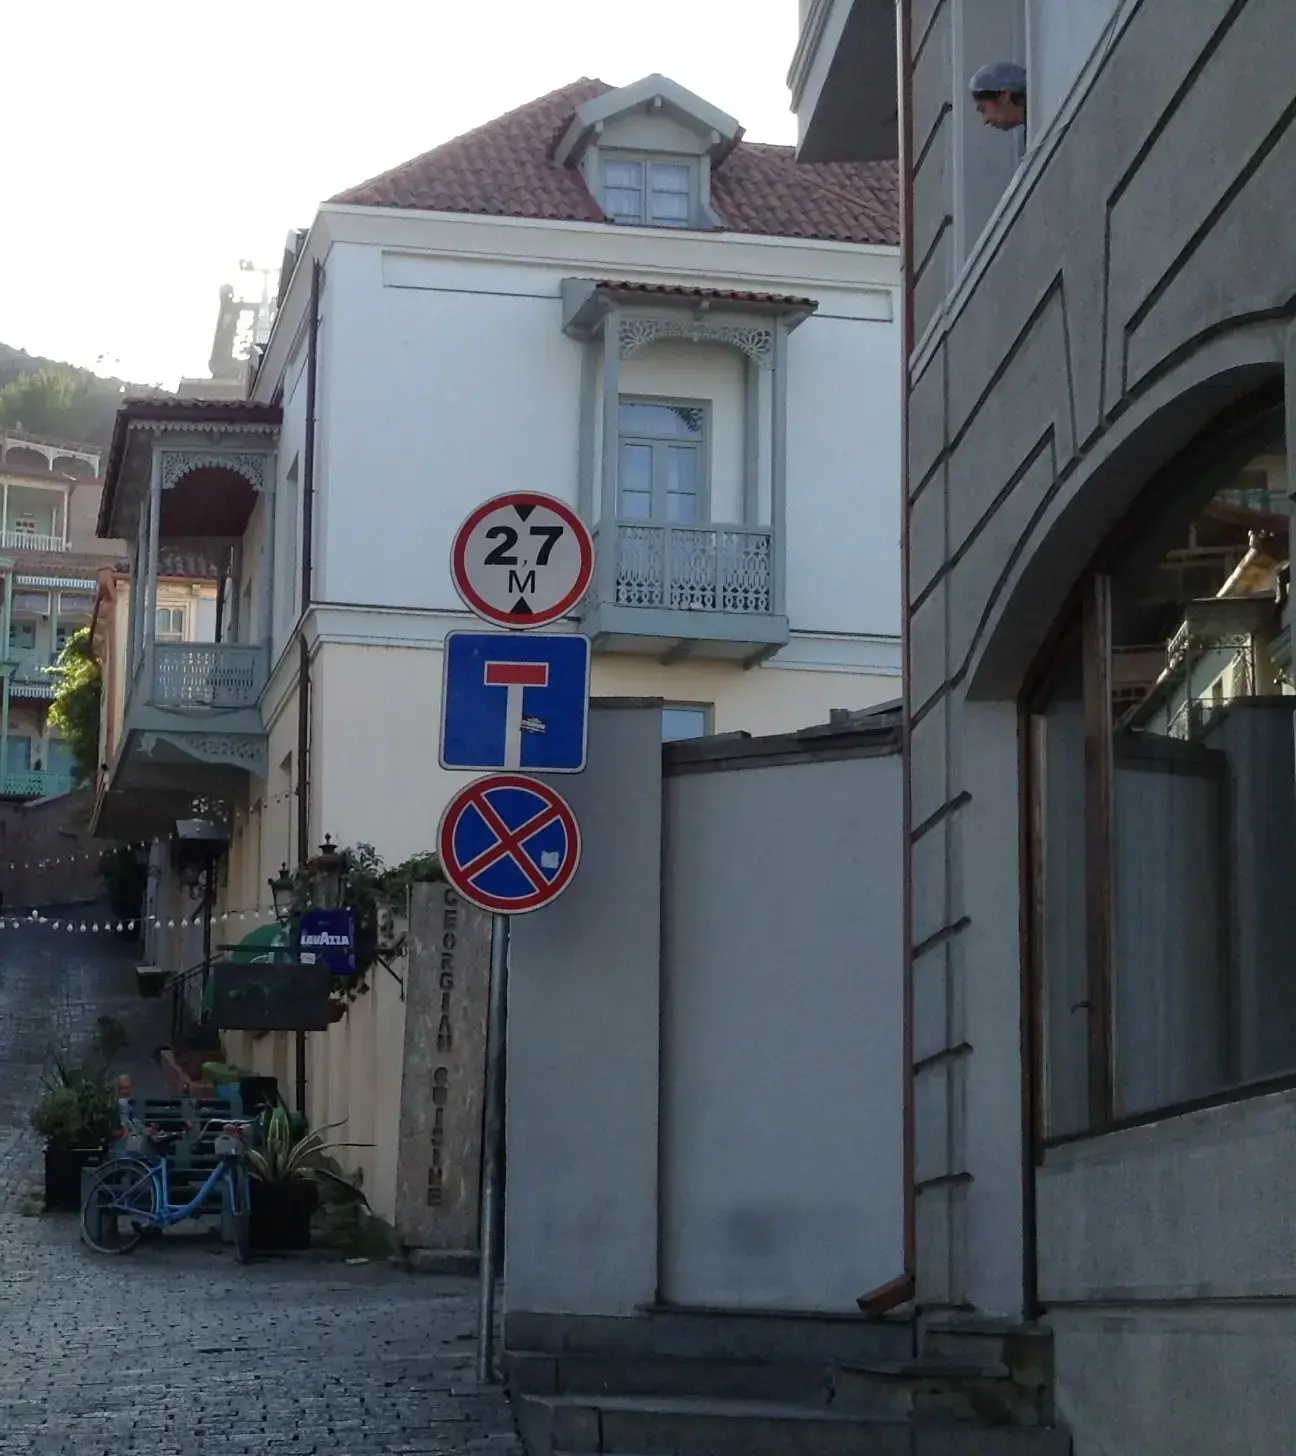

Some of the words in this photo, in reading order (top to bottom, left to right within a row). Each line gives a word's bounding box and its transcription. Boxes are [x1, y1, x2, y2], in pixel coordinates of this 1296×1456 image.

[484, 525, 564, 566] 2,7
[301, 931, 349, 946] LAVAZZA
[438, 888, 458, 1052] GEORGIAN
[428, 1067, 449, 1207] CUISINE
